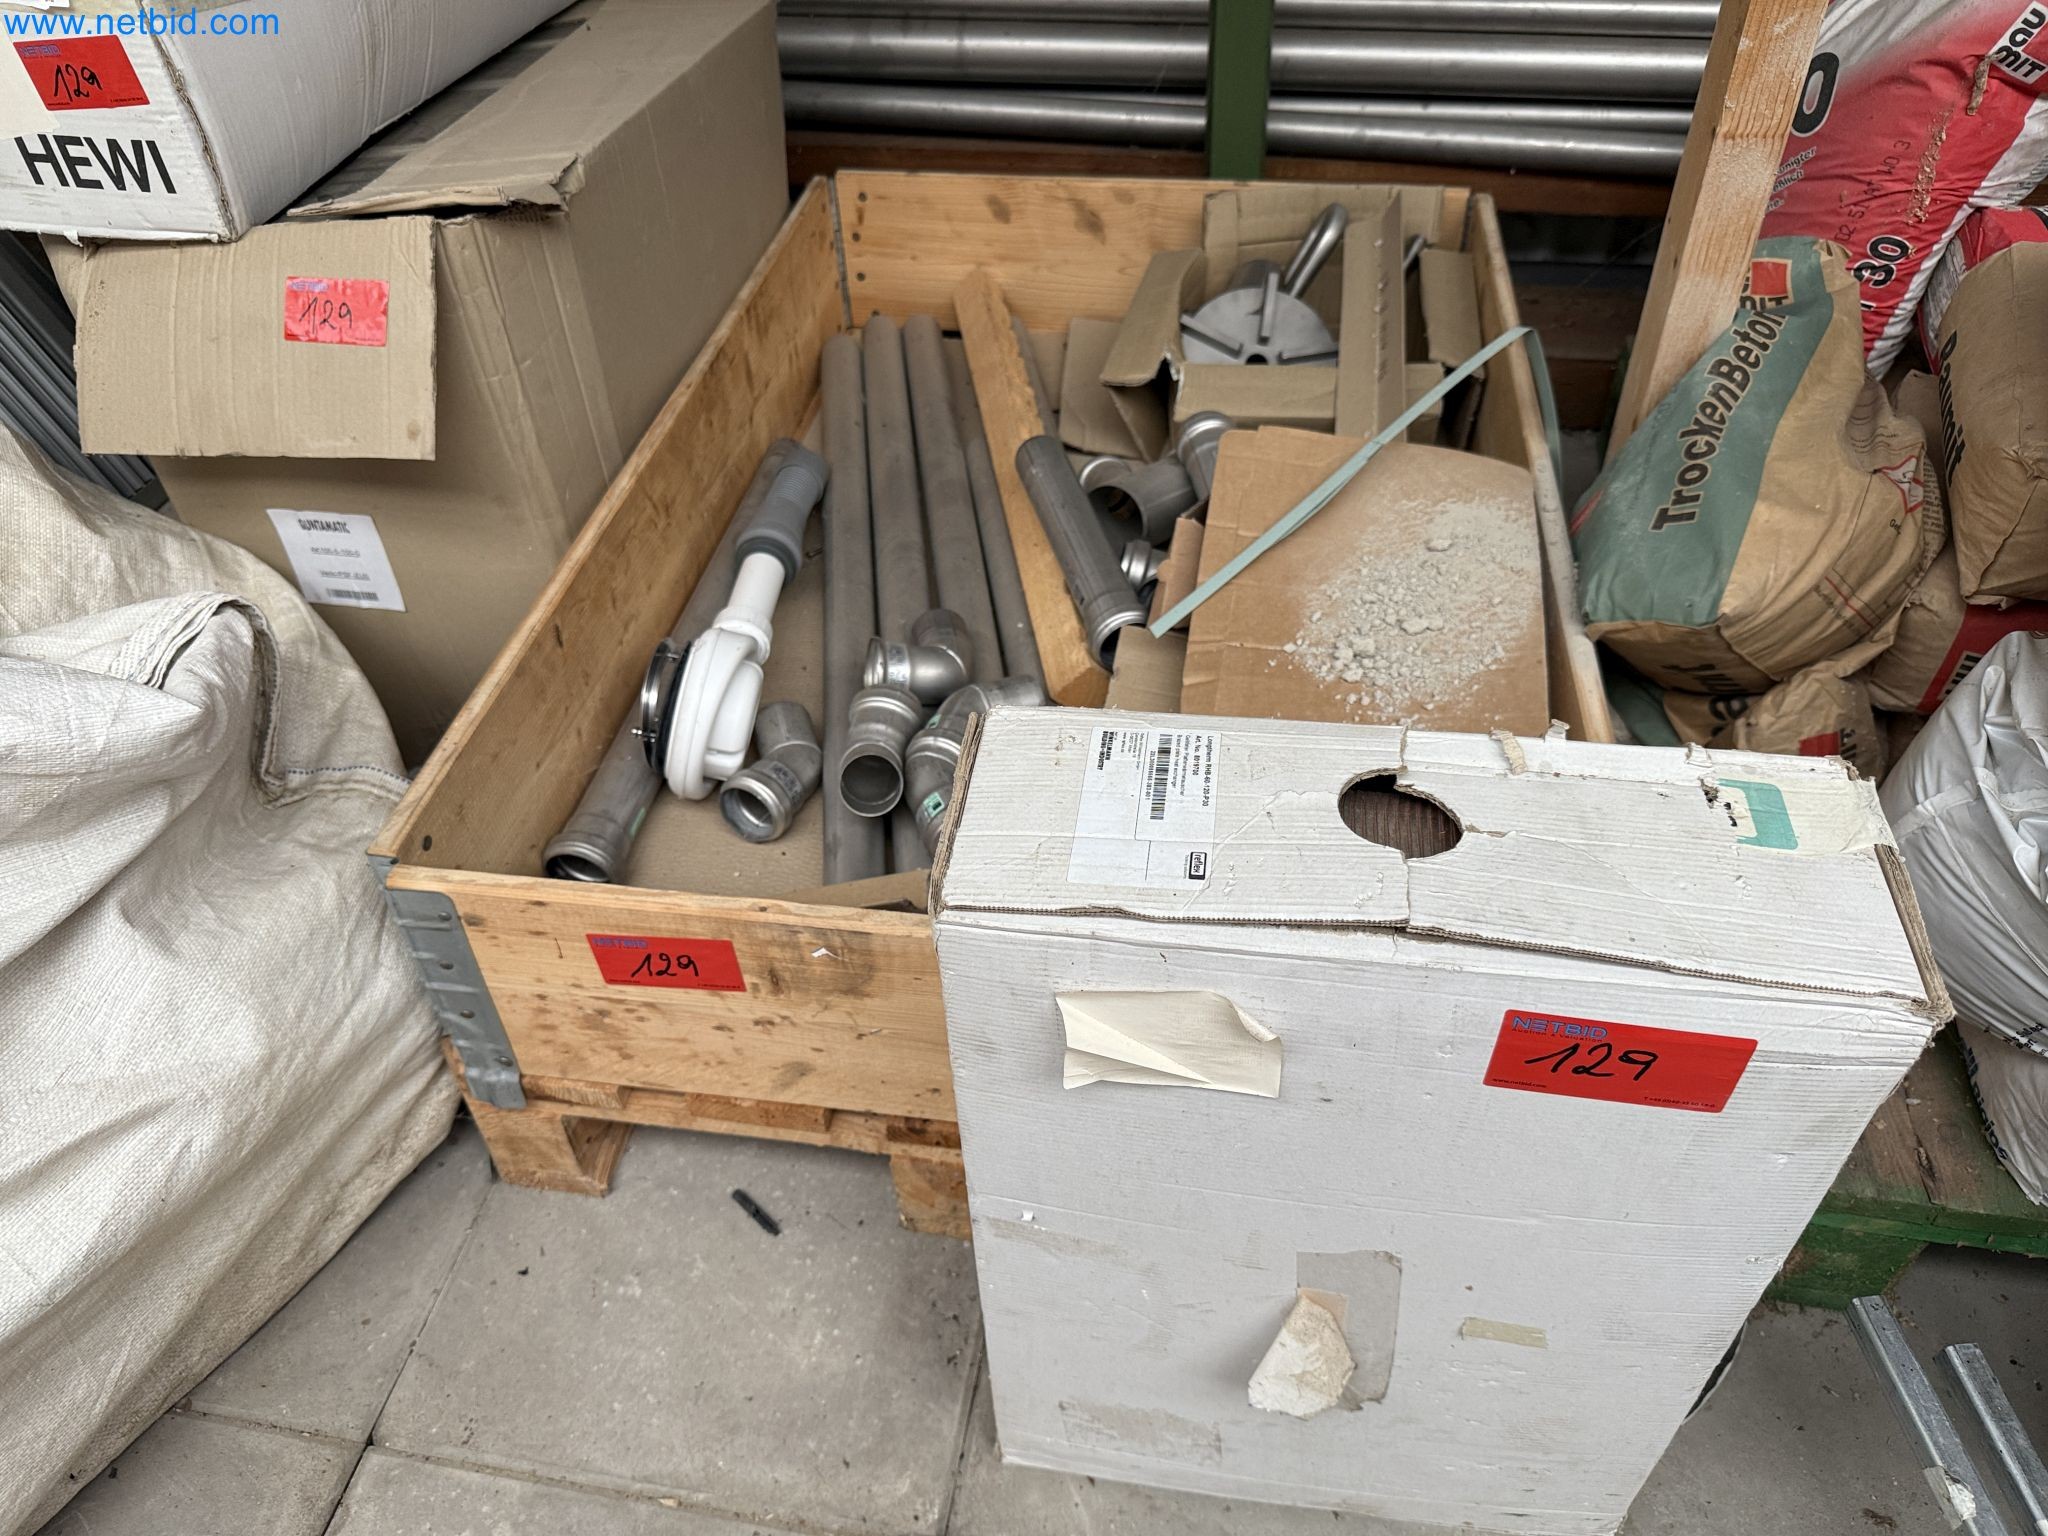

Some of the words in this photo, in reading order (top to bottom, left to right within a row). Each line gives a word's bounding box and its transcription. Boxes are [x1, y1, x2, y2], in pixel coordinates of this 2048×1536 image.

[54, 64, 103, 102] 129
[14, 133, 177, 195] HEWI
[1853, 236, 1911, 288] 30
[299, 297, 352, 334] 129
[1650, 310, 1788, 531] TrockenBeton
[1193, 854, 1203, 873] reflex
[630, 952, 699, 978] 129
[1511, 1016, 1608, 1040] NETBID
[1524, 1043, 1659, 1081] 129
